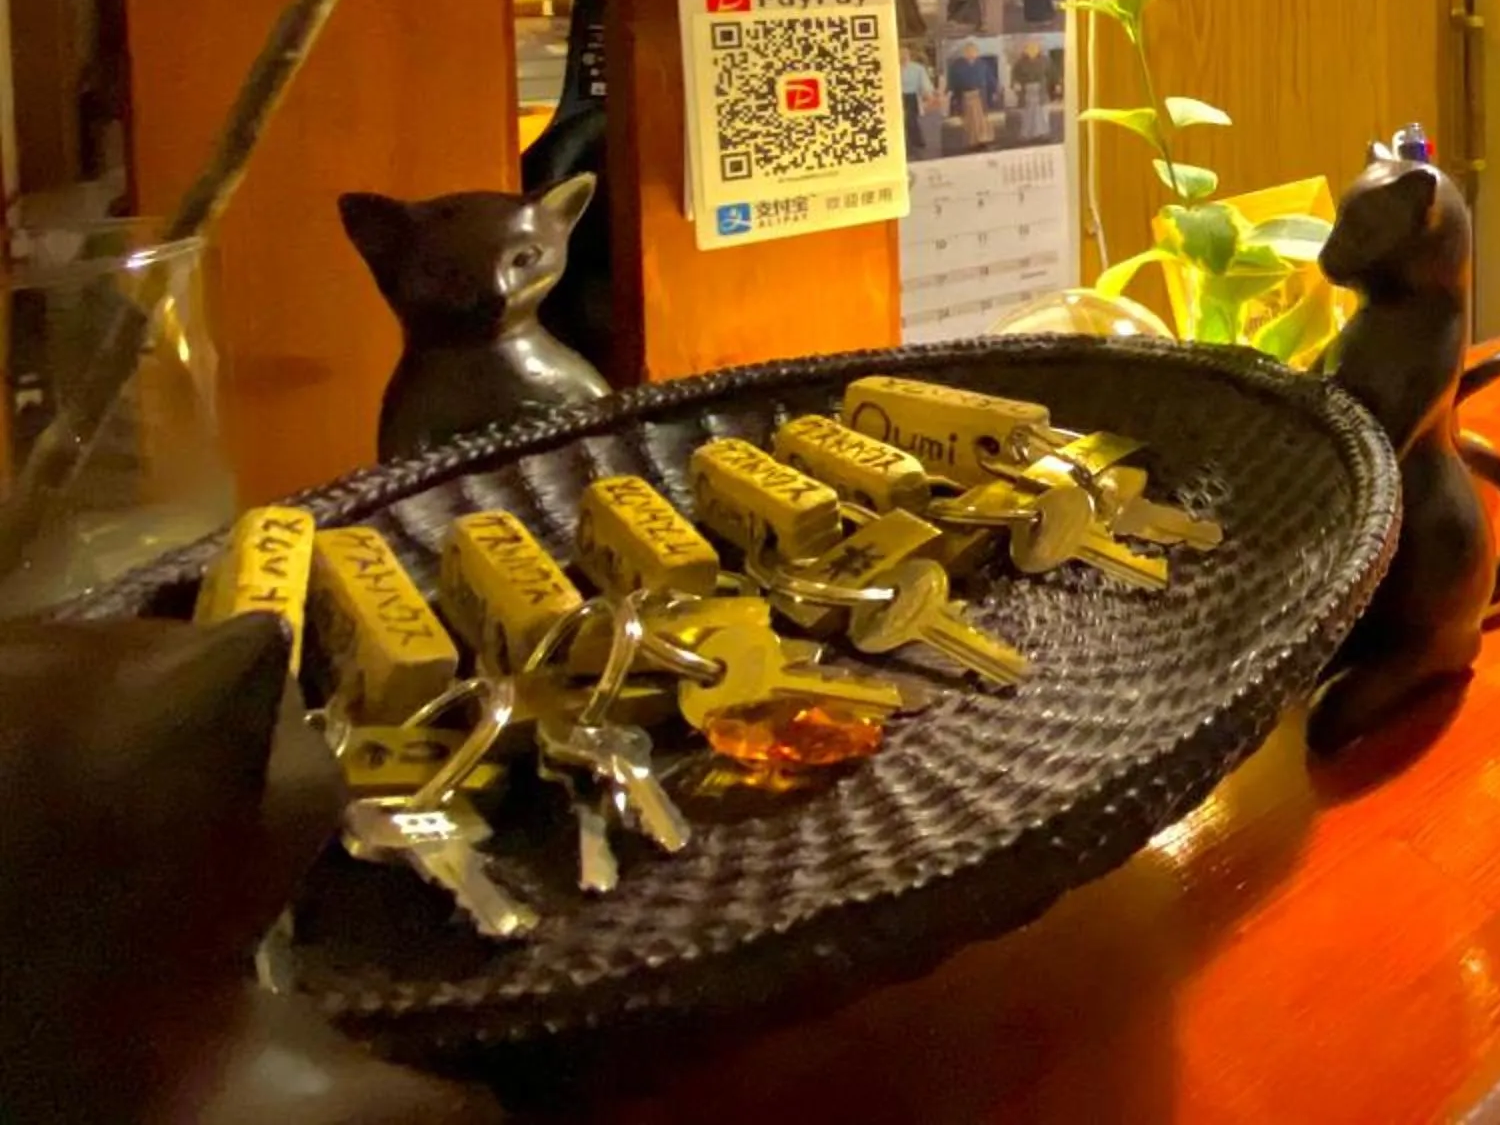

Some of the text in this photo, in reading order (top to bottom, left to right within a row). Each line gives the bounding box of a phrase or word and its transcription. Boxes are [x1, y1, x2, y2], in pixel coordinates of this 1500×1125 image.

[755, 196, 809, 217] 支付宝
[851, 401, 958, 466] Oumi
[250, 517, 303, 605] トハウス
